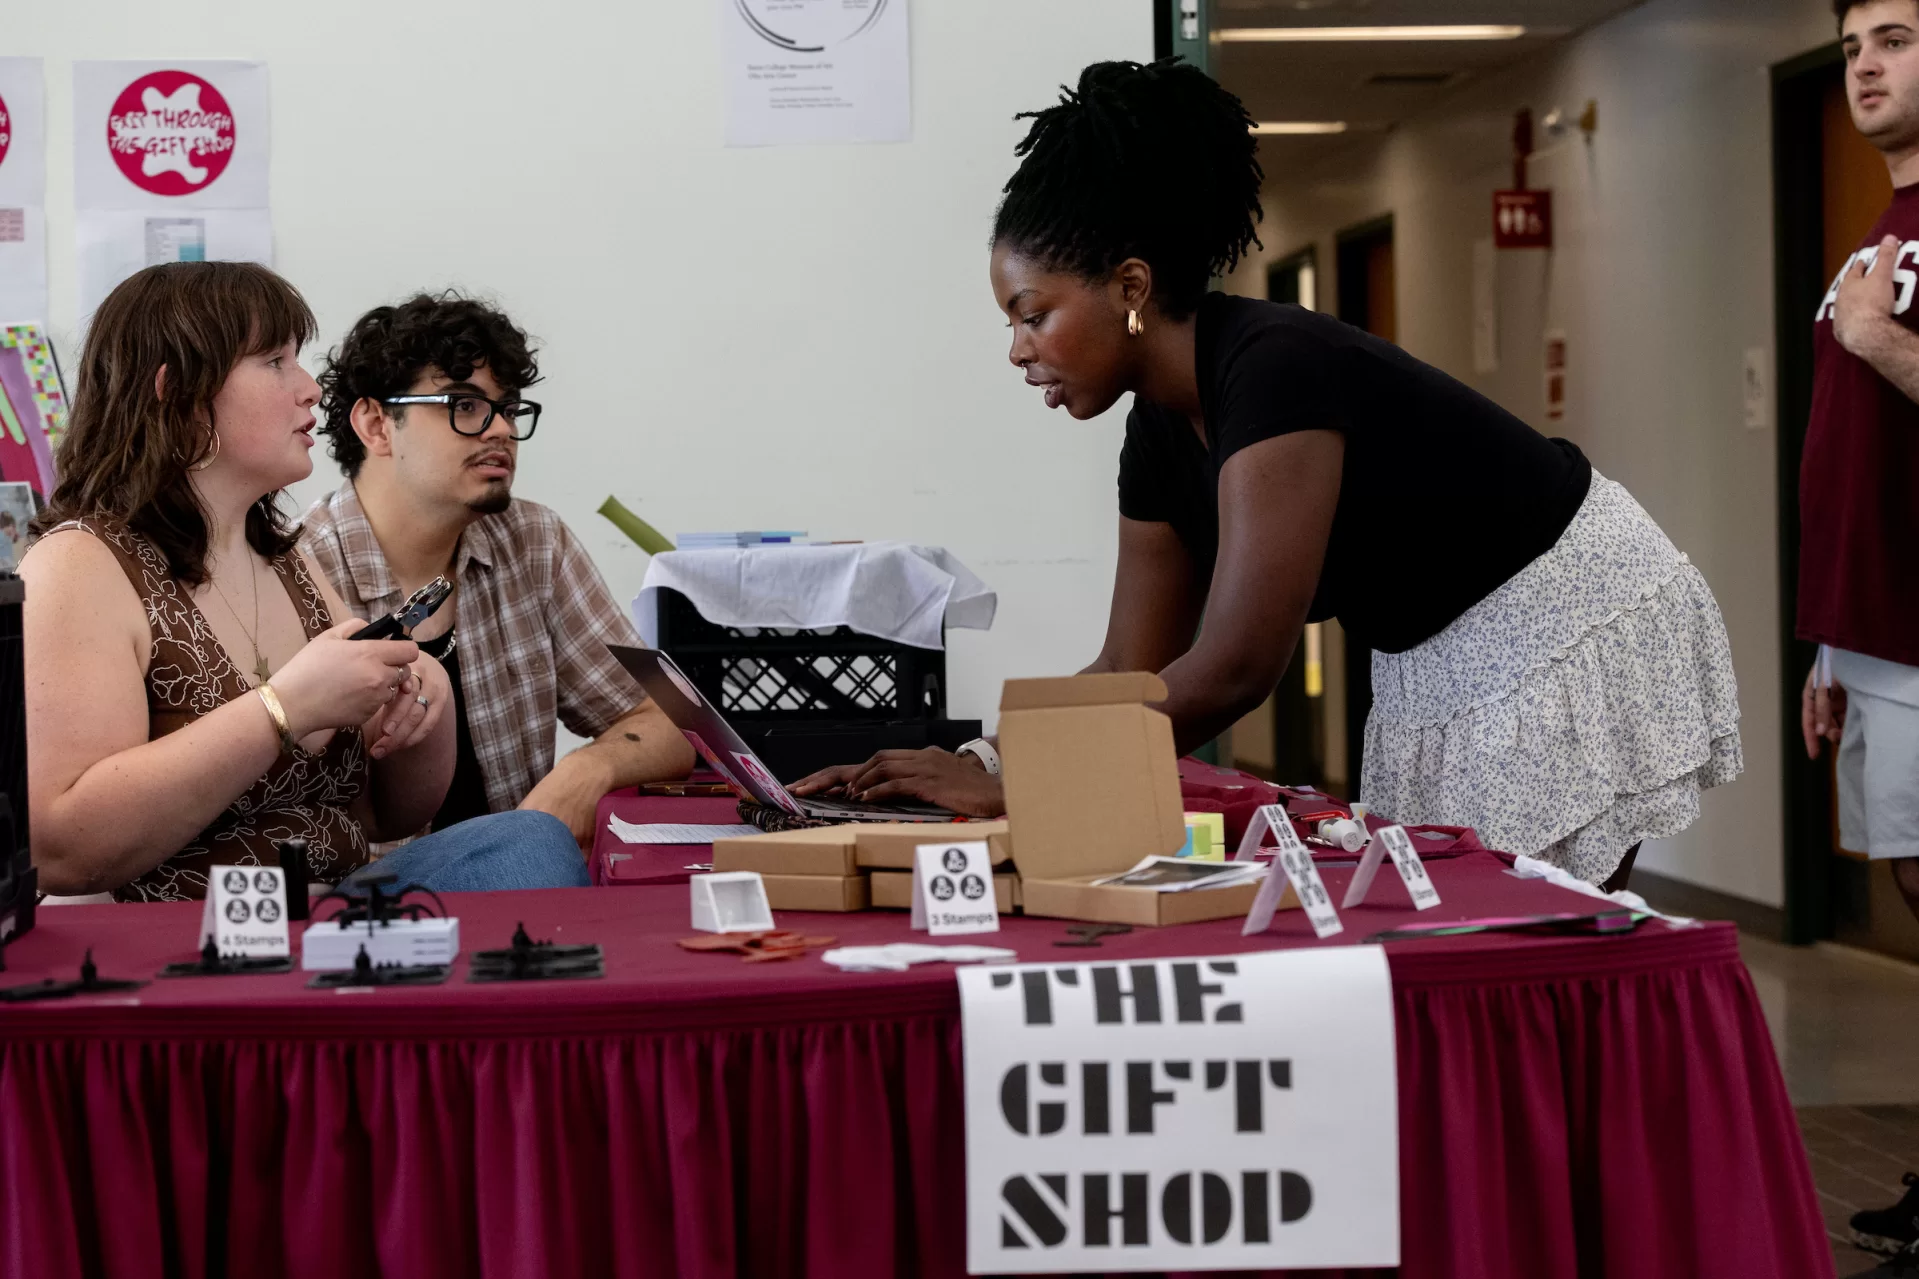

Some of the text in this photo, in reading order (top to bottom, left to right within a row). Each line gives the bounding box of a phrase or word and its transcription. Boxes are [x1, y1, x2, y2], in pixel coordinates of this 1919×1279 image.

[110, 107, 232, 131] EXIT THROUGH
[109, 136, 233, 157] THE GIFT SHOP
[941, 912, 993, 926] Stamps
[222, 934, 284, 948] 4 Stamps
[990, 961, 1244, 1026] THE
[999, 1058, 1293, 1137] GIFT
[1000, 1169, 1314, 1249] SHOP
